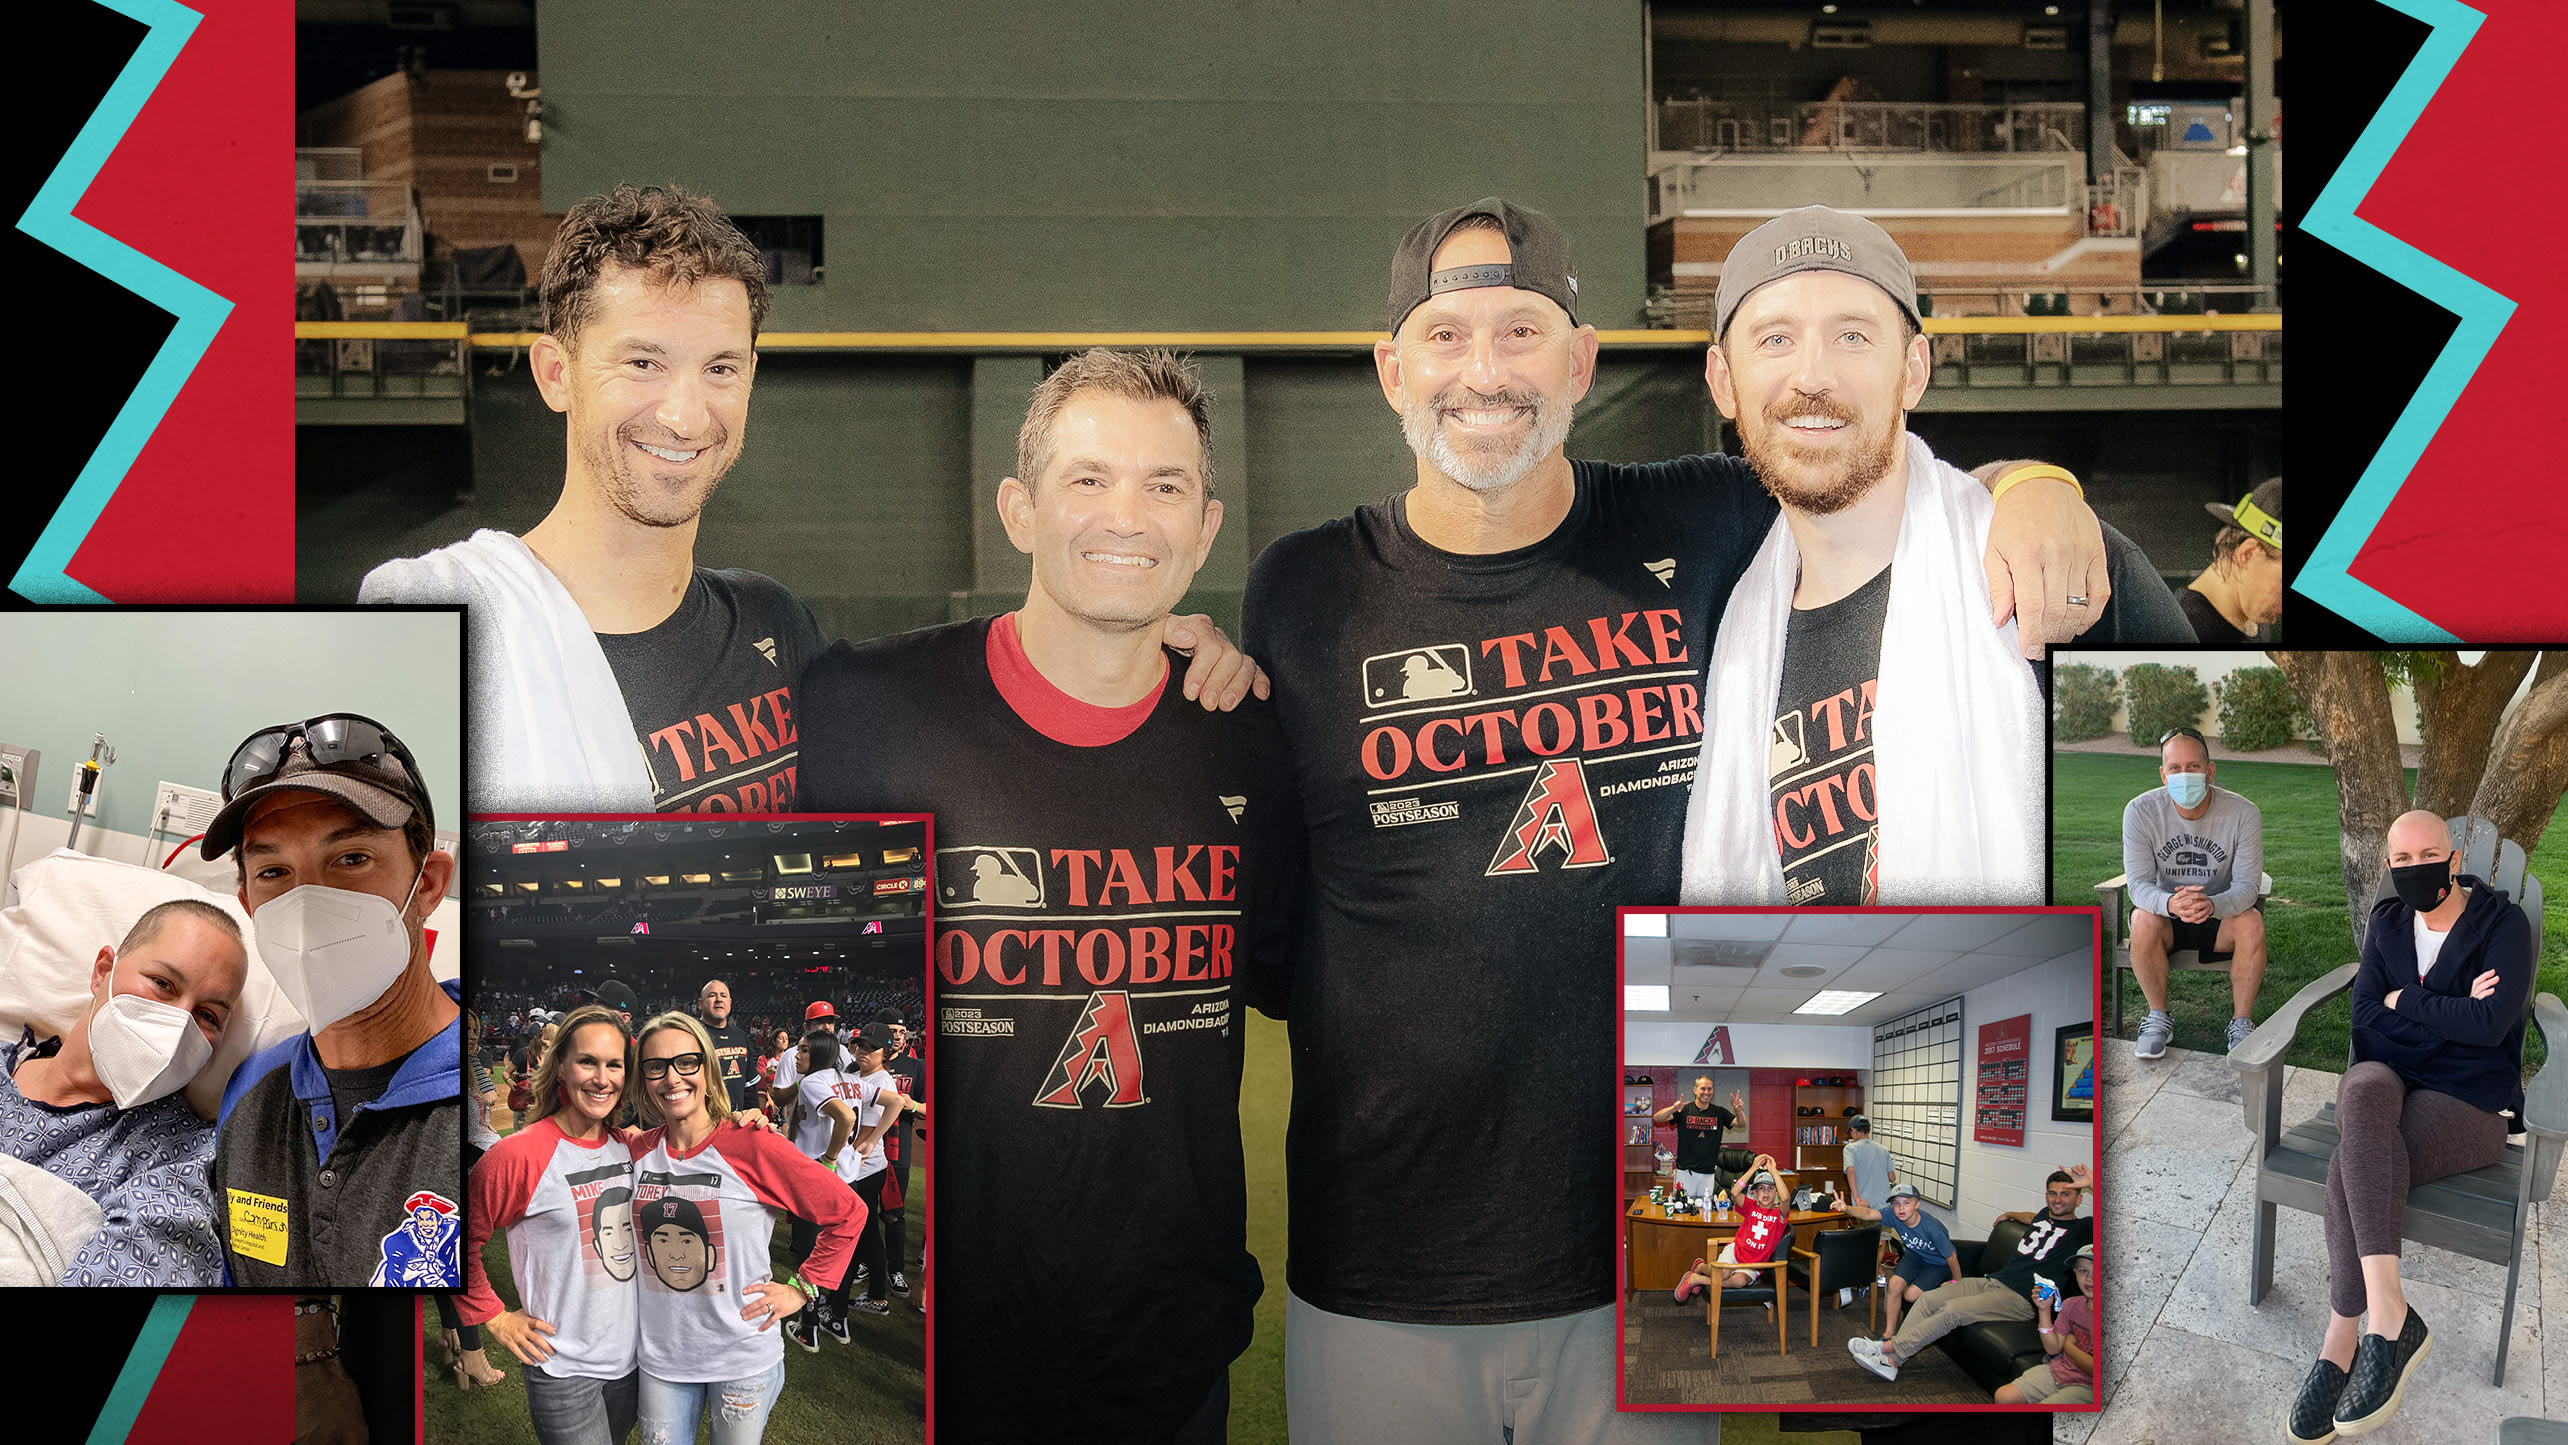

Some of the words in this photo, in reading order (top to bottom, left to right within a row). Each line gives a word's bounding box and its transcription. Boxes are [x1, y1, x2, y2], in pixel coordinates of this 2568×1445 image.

[1481, 608, 1689, 689] TAKE
[648, 686, 799, 782] TAKE
[1361, 683, 1704, 781] OCTOBER
[1657, 755, 1699, 773] ARIZON
[1600, 770, 1696, 797] DIAMONDBAC
[1372, 804, 1460, 825] POSTSEASON
[1389, 800, 1420, 811] 2023
[2157, 835, 2184, 862] GEORGE
[1050, 845, 1240, 907] TAKE
[2165, 867, 2218, 878] UNIVERSITY
[876, 883, 898, 891] CIRCLE
[935, 924, 1236, 986] OCTOBER
[954, 1010, 982, 1019] 2023
[941, 1021, 1015, 1034] POSTSEASON
[1996, 1041, 2021, 1053] SCHEDULE
[709, 1176, 719, 1186] 17
[570, 1181, 603, 1201] MIKE
[635, 1184, 668, 1200] TOREY
[236, 1195, 253, 1206] and
[253, 1198, 288, 1213] Friends
[663, 1202, 678, 1218] 17
[248, 1230, 267, 1242] Health
[1746, 1238, 1757, 1249] ON
[2017, 1220, 2068, 1261] 31
